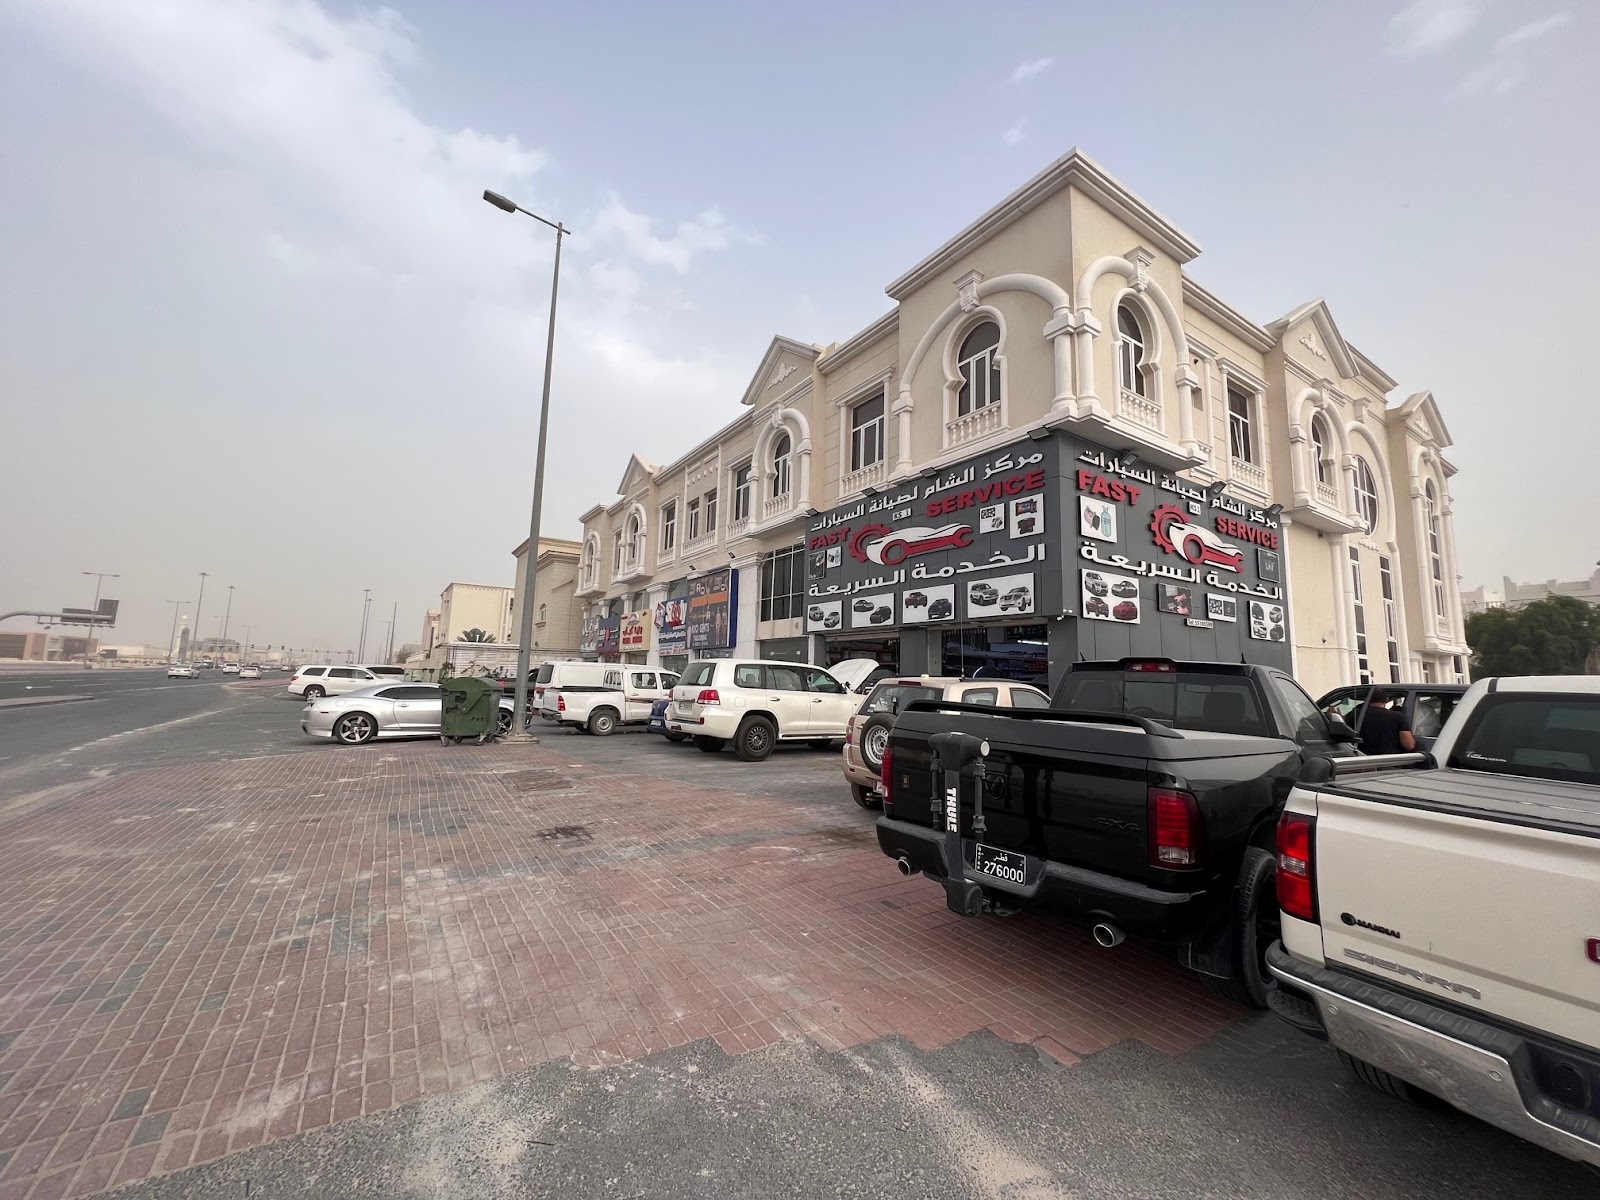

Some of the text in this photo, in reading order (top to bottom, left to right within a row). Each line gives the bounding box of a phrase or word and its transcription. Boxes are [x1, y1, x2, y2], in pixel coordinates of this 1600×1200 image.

[808, 469, 1046, 550] FAST SERVICE
[810, 451, 1044, 531] مركز الشام لصيانة السيارات
[1077, 468, 1280, 550] FAST SERVICE
[1078, 450, 1278, 529] مركز الشام لصيانة السيارات
[808, 543, 1047, 597] الخدمة السريعة
[1080, 541, 1283, 600] الخدمة السريعة
[947, 788, 957, 833] THULE
[984, 861, 1023, 883] 276000
[993, 853, 1008, 862] قطر
[1343, 947, 1482, 1001] SIERRA
